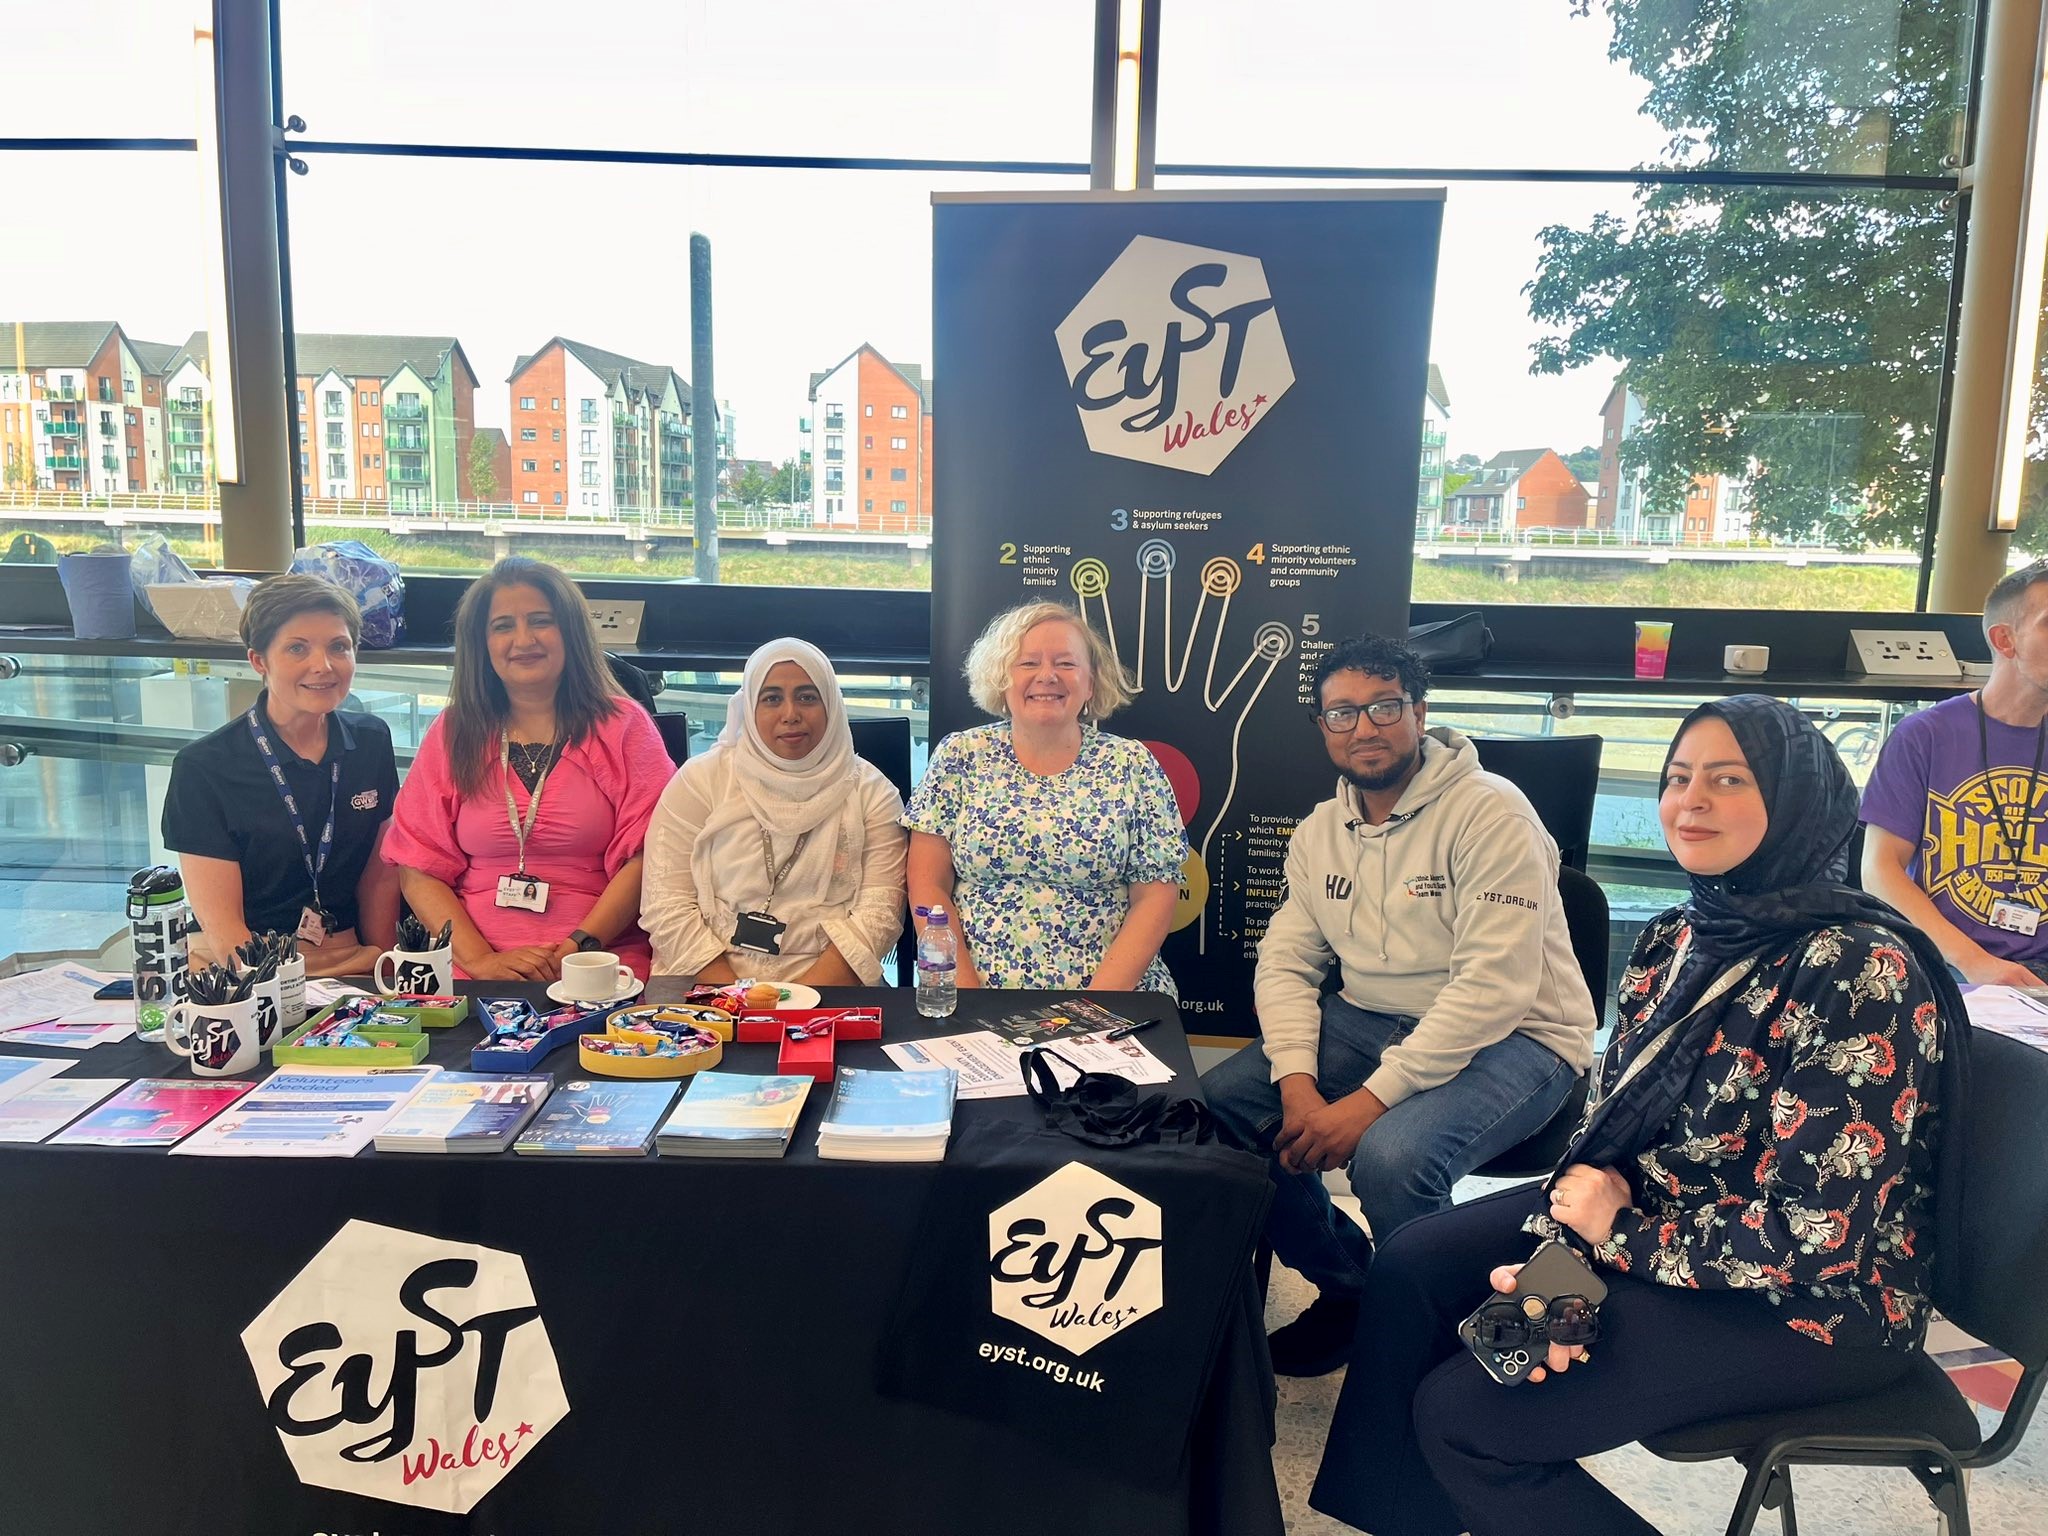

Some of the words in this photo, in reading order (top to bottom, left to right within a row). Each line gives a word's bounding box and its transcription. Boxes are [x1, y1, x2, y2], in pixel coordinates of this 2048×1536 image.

[1164, 403, 1256, 453] Wales
[1110, 508, 1128, 531] 3
[1132, 509, 1182, 520] Supporting
[1183, 511, 1222, 520] refugees
[1132, 521, 1140, 530] &
[1141, 521, 1172, 531] asylum
[1174, 522, 1209, 530] seekers
[999, 542, 1017, 565] 2
[1023, 544, 1071, 555] Supporting
[1246, 543, 1265, 565] 4
[1272, 544, 1321, 554] Supporting
[1322, 545, 1351, 554] ethnic
[1023, 555, 1050, 564] ethnic
[1271, 556, 1308, 566] minority
[1309, 556, 1357, 566] volunteers
[1023, 566, 1059, 576] minority
[1270, 567, 1288, 575] and
[1289, 567, 1339, 578] community
[1023, 577, 1057, 586] families
[1270, 578, 1301, 588] groups
[1301, 613, 1320, 636] 5
[1300, 652, 1317, 660] and
[1957, 776, 2048, 817] SCOT
[1249, 814, 1260, 822] To
[1261, 815, 1294, 825] provide
[1249, 825, 1275, 835] which
[1248, 837, 1284, 848] minority
[1934, 802, 2048, 883] HAL
[1248, 848, 1281, 857] families
[1247, 865, 1257, 874] To
[1258, 866, 1280, 875] work
[1953, 869, 1973, 888] THE
[1245, 917, 1255, 925] To
[1244, 928, 1266, 937] DIVE
[1703, 979, 1728, 1001] STAFF
[276, 1075, 375, 1085] Volunteers
[265, 1083, 340, 1091] Needed
[1050, 1302, 1127, 1331] Wales
[978, 1341, 1105, 1392] eyst.org.uk
[403, 1424, 519, 1485] Wales
